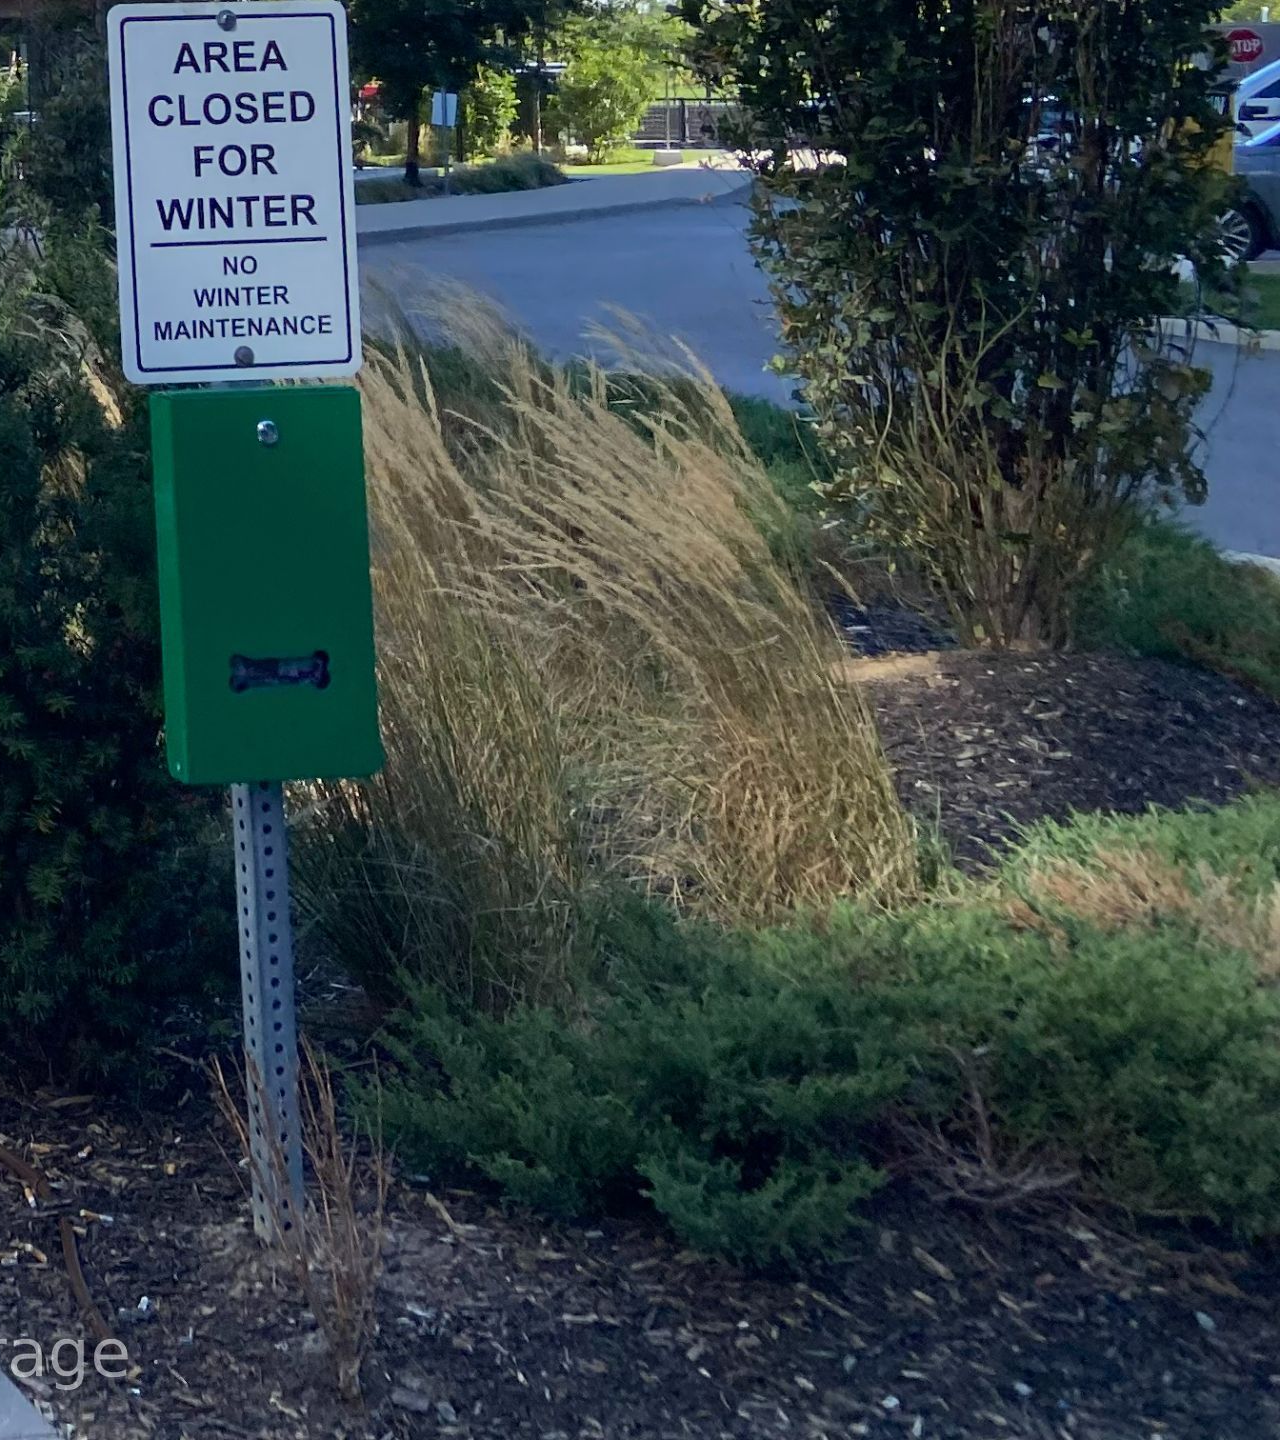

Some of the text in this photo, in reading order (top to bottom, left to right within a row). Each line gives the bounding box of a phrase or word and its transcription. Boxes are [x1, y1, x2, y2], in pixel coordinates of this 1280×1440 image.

[173, 40, 288, 74] AREA
[148, 91, 316, 127] CLOSED
[193, 144, 278, 177] FOR
[156, 195, 317, 231] WINTER
[223, 255, 258, 275] NO
[193, 285, 289, 308] WINTER
[154, 315, 332, 341] MAINTENANCE
